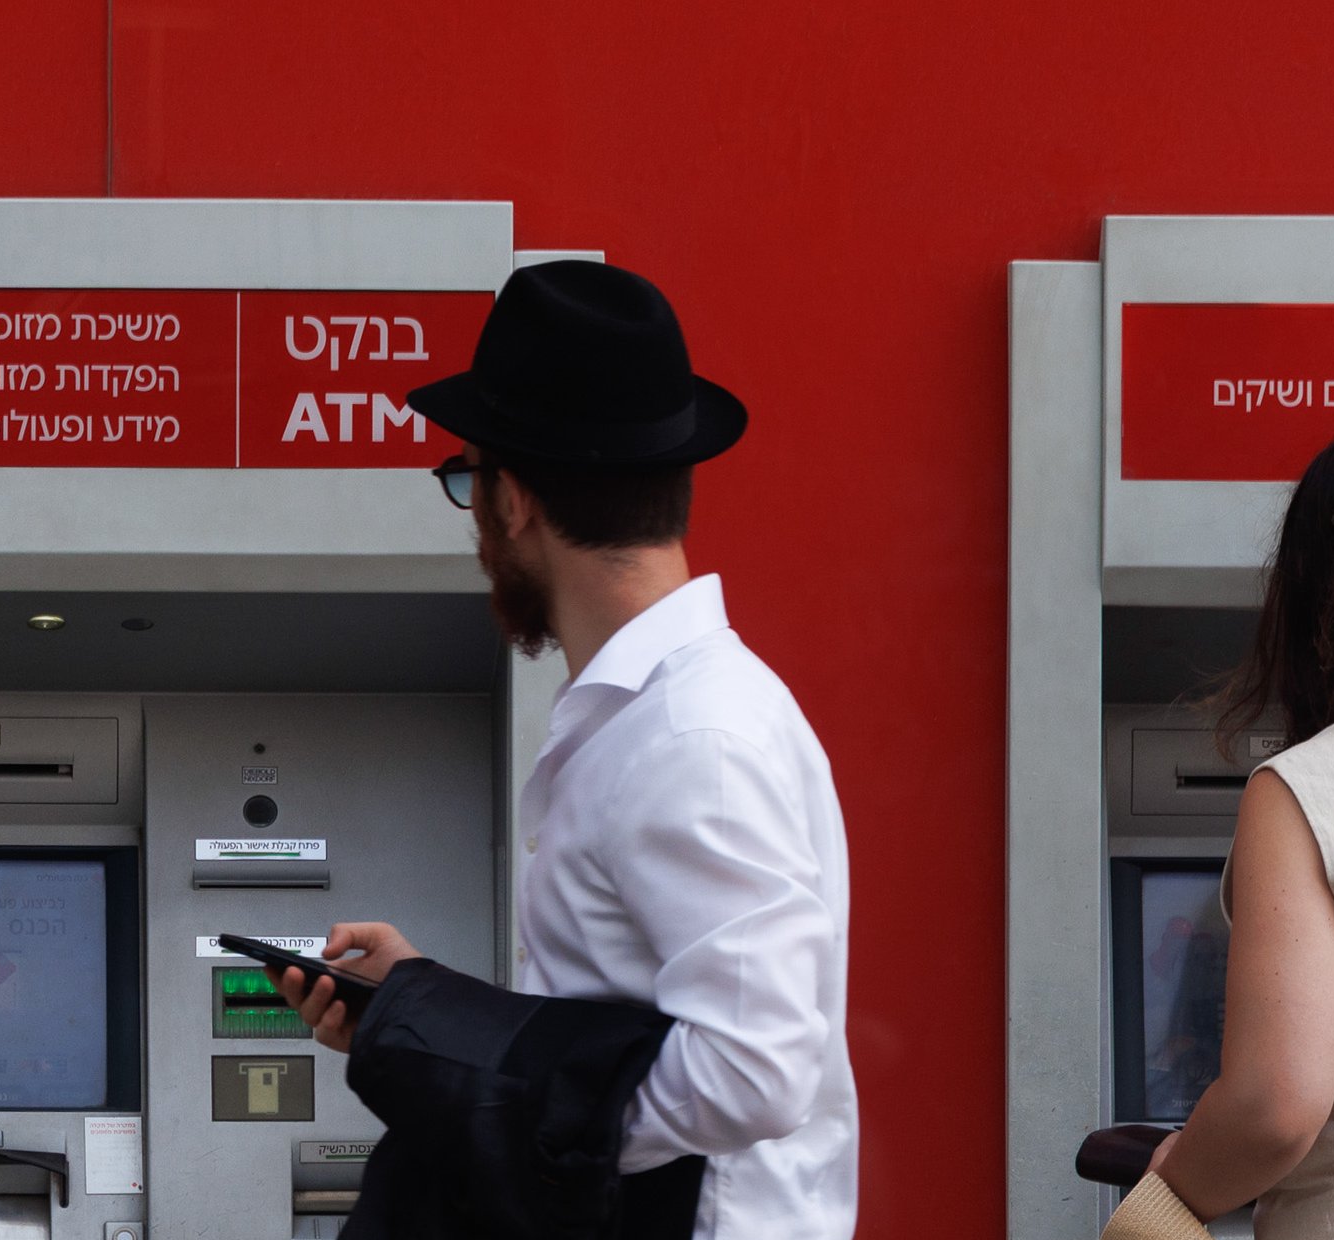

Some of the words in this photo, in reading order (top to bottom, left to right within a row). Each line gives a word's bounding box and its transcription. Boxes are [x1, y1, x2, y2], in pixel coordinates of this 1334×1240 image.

[70, 313, 181, 342] משיכת
[285, 315, 430, 372] בנקט
[54, 363, 181, 398] הפקדות
[1213, 379, 1313, 413] ושיקים
[281, 392, 427, 443] ATM
[102, 415, 181, 443] מידע
[209, 841, 243, 850] הפעולה
[244, 842, 269, 850] אישור
[271, 841, 297, 852] קבלת
[298, 842, 320, 850] פתח
[289, 938, 315, 947] פתח
[318, 1144, 347, 1156] השיק
